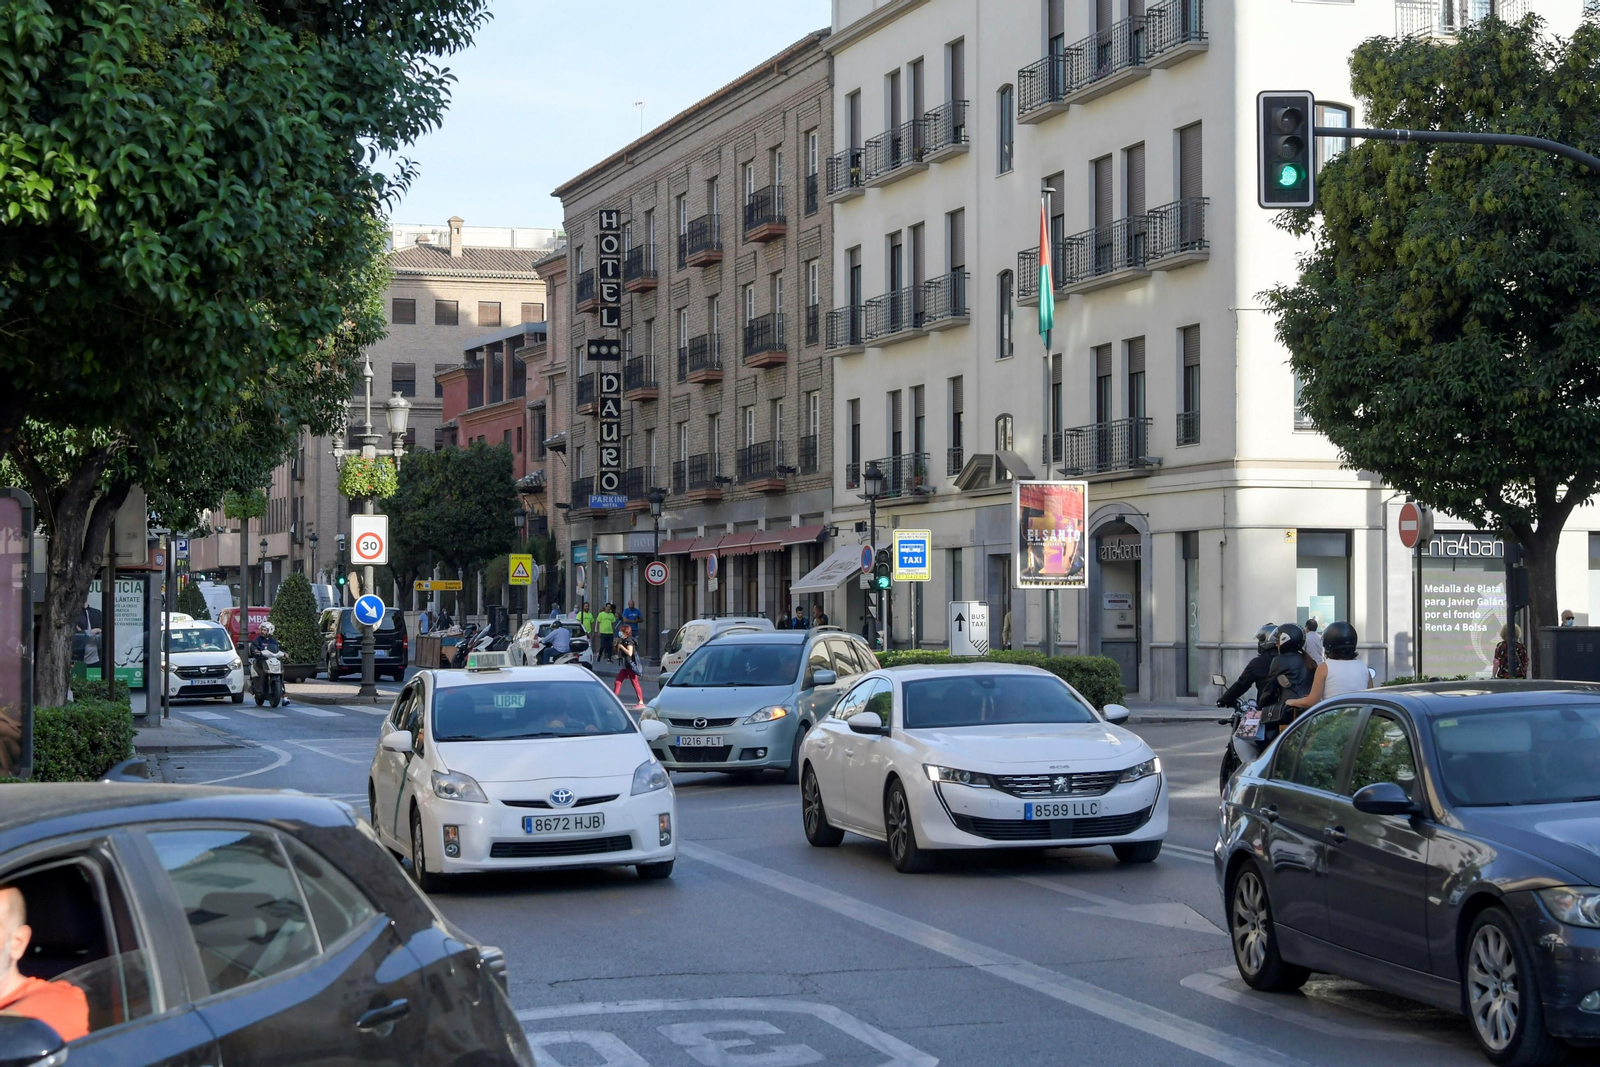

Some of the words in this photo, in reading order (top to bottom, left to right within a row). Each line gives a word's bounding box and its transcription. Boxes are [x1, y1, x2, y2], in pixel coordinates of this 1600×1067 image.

[601, 211, 618, 326] HOTEL
[601, 374, 618, 490] DAURO
[1027, 529, 1040, 542] EL
[1042, 525, 1080, 543] SANTO
[362, 542, 377, 550] 30
[1421, 534, 1504, 556] nta4ban
[88, 582, 142, 593] JUICIA
[1425, 584, 1461, 593] Medalla
[1464, 584, 1474, 593] de
[1478, 584, 1500, 593] Plata
[1425, 599, 1446, 608] para
[1448, 597, 1474, 606] Javier
[1477, 597, 1504, 606] Galán
[248, 615, 270, 624] MBA
[1425, 612, 1440, 621] por
[1443, 610, 1451, 618] el
[1454, 610, 1480, 618] fondo
[1425, 623, 1452, 632] Renta
[1454, 623, 1460, 631] 4
[1463, 623, 1487, 632] Bolsa
[682, 737, 701, 746] 0216
[707, 737, 721, 745] FLT
[1035, 804, 1068, 817] 8589
[1073, 803, 1097, 815] LLC
[536, 818, 570, 831] 8672
[575, 816, 600, 829] HJB
